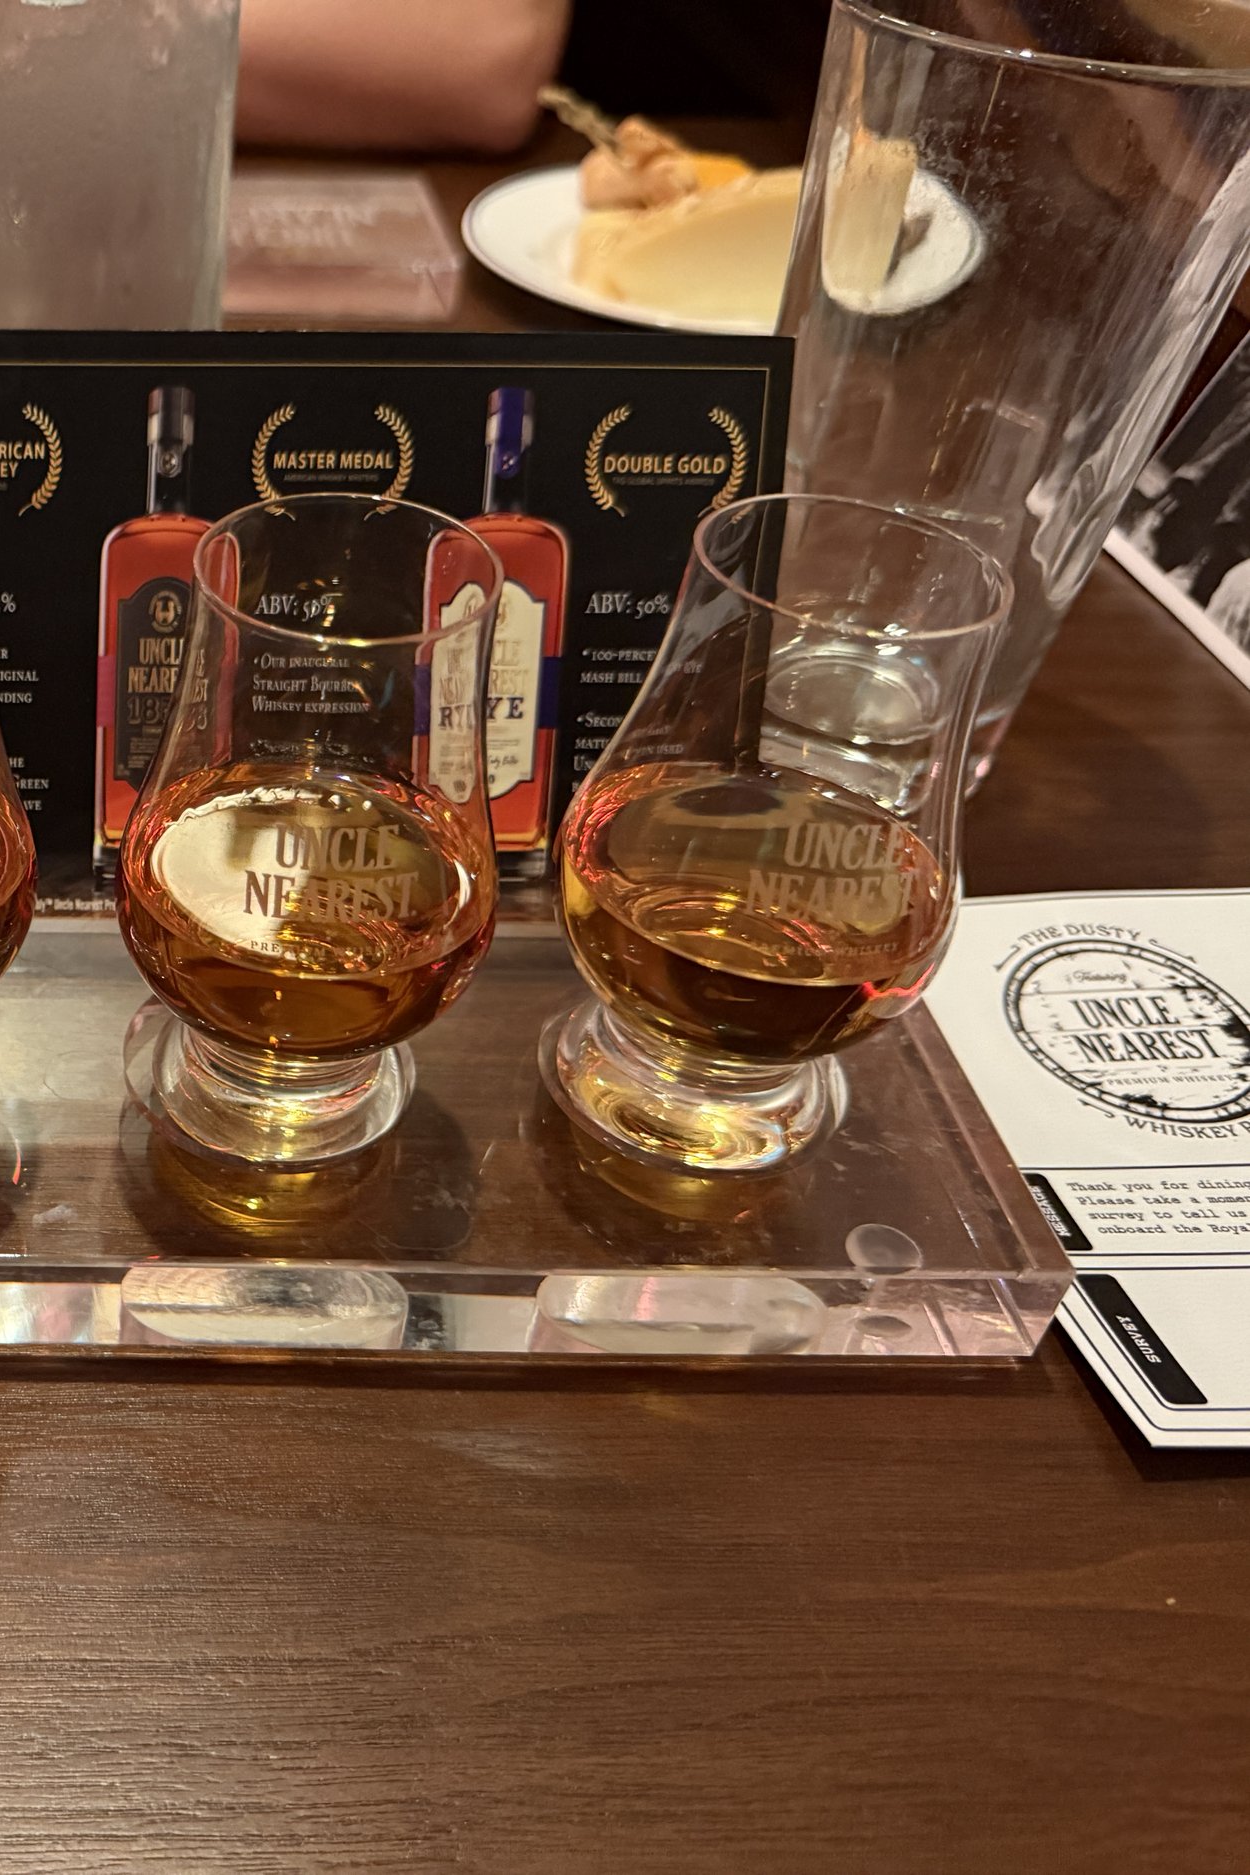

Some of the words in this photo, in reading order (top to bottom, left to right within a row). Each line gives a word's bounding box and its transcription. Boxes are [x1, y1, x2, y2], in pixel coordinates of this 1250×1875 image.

[273, 451, 335, 470] MASTER
[339, 451, 394, 470] MEDAL
[603, 455, 672, 475] DOUBLE
[677, 456, 727, 475] GOLD
[254, 594, 298, 616] ABV:
[584, 594, 632, 615] ABV:
[634, 594, 671, 620] 50%
[591, 649, 657, 662] 100-PERCE
[127, 666, 180, 694] NEARE
[252, 674, 307, 691] STRAIGHT
[490, 668, 529, 695] REST
[580, 672, 613, 684] MASH
[617, 672, 643, 684] BILL
[251, 695, 302, 712] WHISKEY
[304, 701, 370, 714] EXPRESSION
[486, 696, 525, 720] YE
[584, 711, 623, 728] SECON
[8, 757, 25, 768] HE
[273, 822, 401, 873] UNCLE
[783, 820, 910, 872] UNCLE
[242, 869, 419, 925] NEAREST
[744, 867, 921, 929] NEAREST
[1017, 926, 1063, 949] THE
[1064, 922, 1143, 942] DUSTY
[1069, 995, 1181, 1029] UNCLE
[1069, 1029, 1222, 1064] NEAREST
[1106, 1075, 1171, 1086] PREMIUM
[1172, 1073, 1234, 1083] WHISKEY
[1122, 1114, 1240, 1140] WHISKEY
[1066, 1181, 1116, 1193] Thank
[1121, 1182, 1155, 1194] you
[1160, 1180, 1189, 1190] for
[1076, 1195, 1136, 1206] Please
[1144, 1195, 1181, 1205] take
[1189, 1196, 1201, 1204] a
[1208, 1195, 1250, 1204] momen
[1087, 1211, 1145, 1222] survey
[1154, 1210, 1173, 1219] to
[1180, 1209, 1220, 1219] tell
[1226, 1210, 1248, 1218] us
[1097, 1224, 1166, 1235] onboard
[1173, 1224, 1202, 1234] the
[1115, 1314, 1163, 1364] SURVEY
